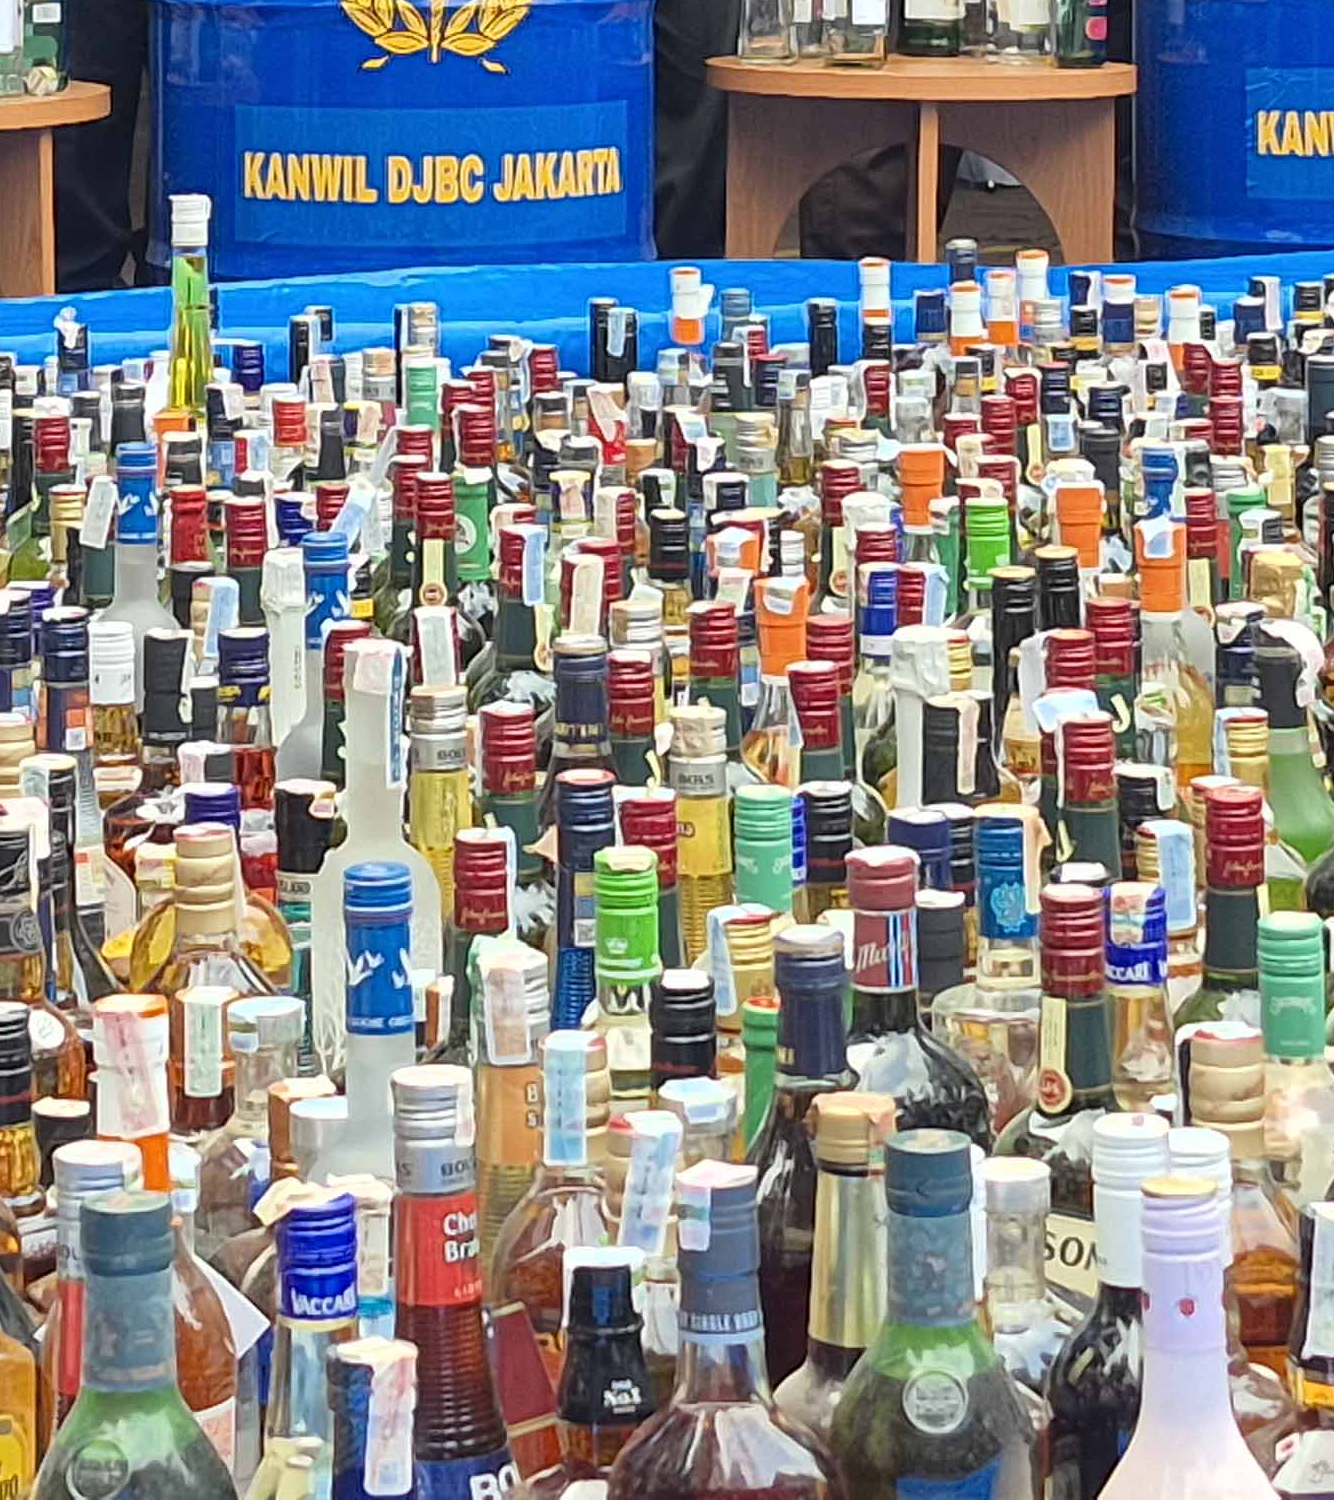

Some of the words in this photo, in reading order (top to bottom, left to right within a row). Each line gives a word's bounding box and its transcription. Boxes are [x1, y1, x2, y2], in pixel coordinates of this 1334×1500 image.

[244, 152, 378, 204] KANWIL
[387, 155, 484, 205] DJBC
[494, 148, 621, 202] JAKARTA
[440, 1161, 478, 1180] BOL
